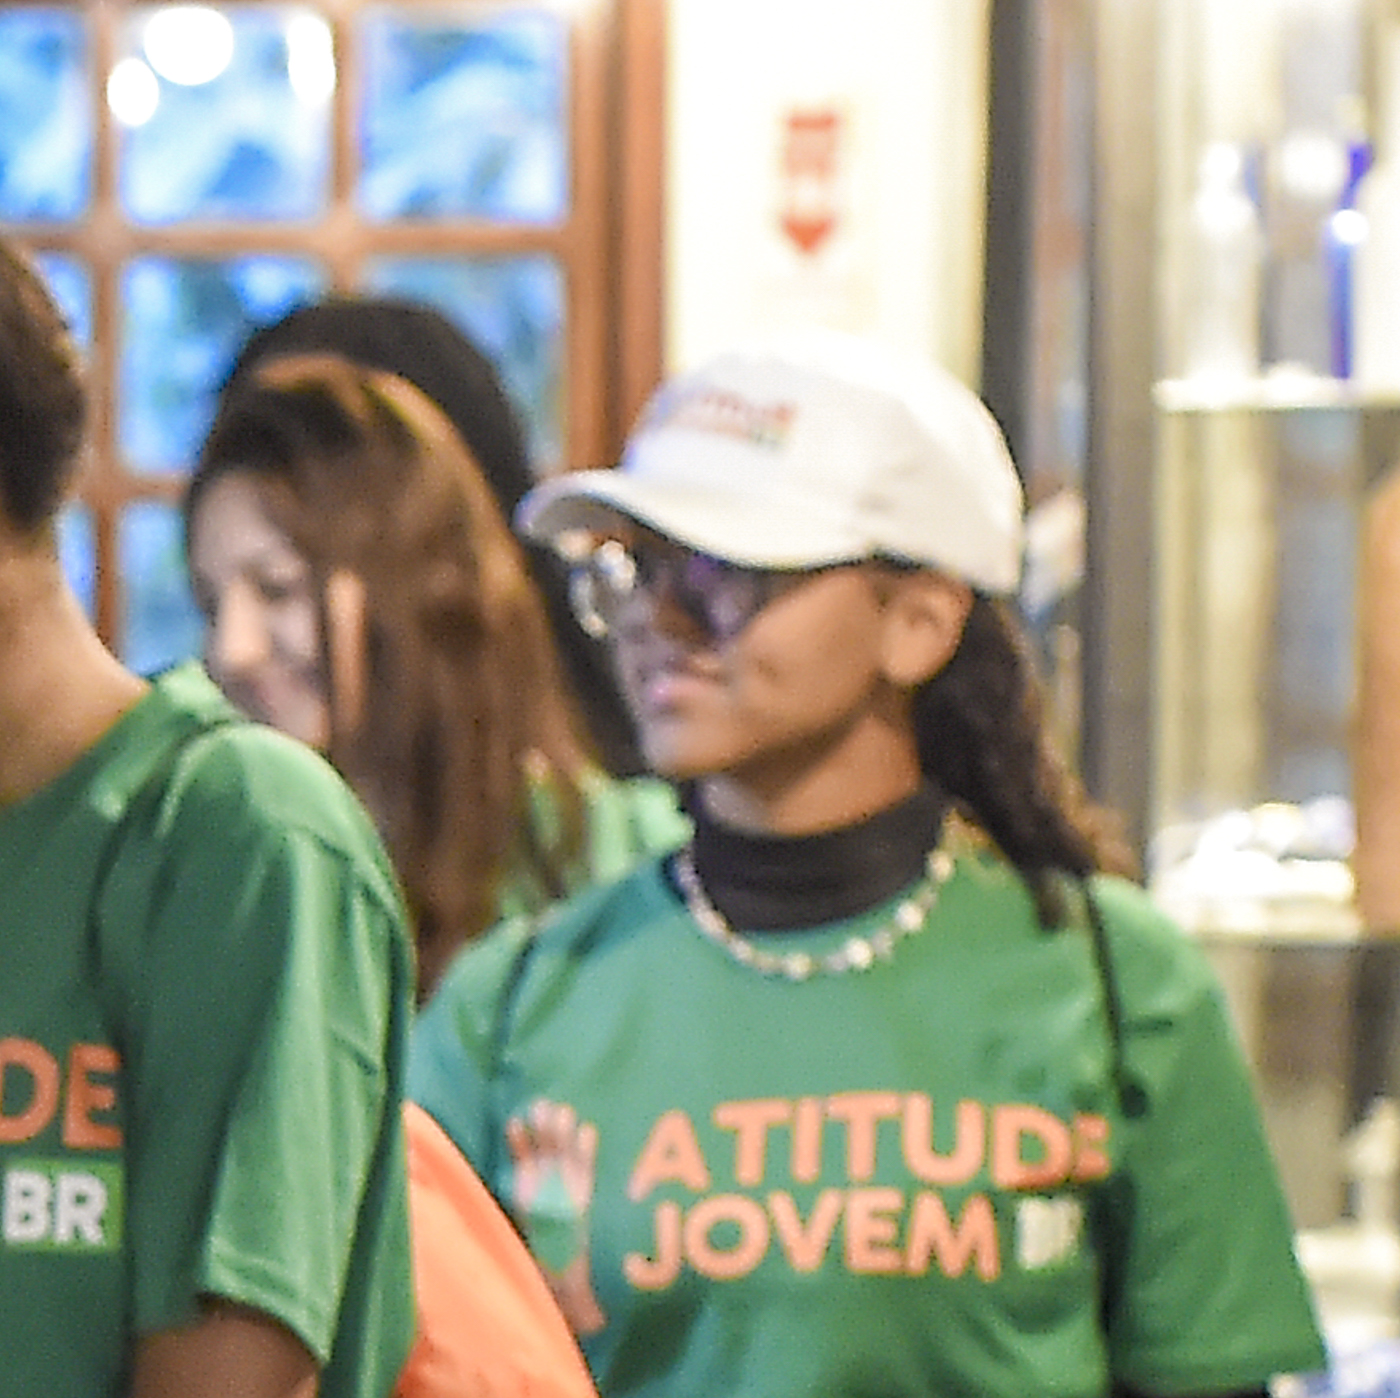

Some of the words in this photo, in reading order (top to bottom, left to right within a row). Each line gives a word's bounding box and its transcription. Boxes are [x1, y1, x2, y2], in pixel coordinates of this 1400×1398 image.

[627, 1091, 1112, 1202] ATITUDE
[3, 1168, 108, 1246] BR
[623, 1188, 1002, 1290] JOVEM
